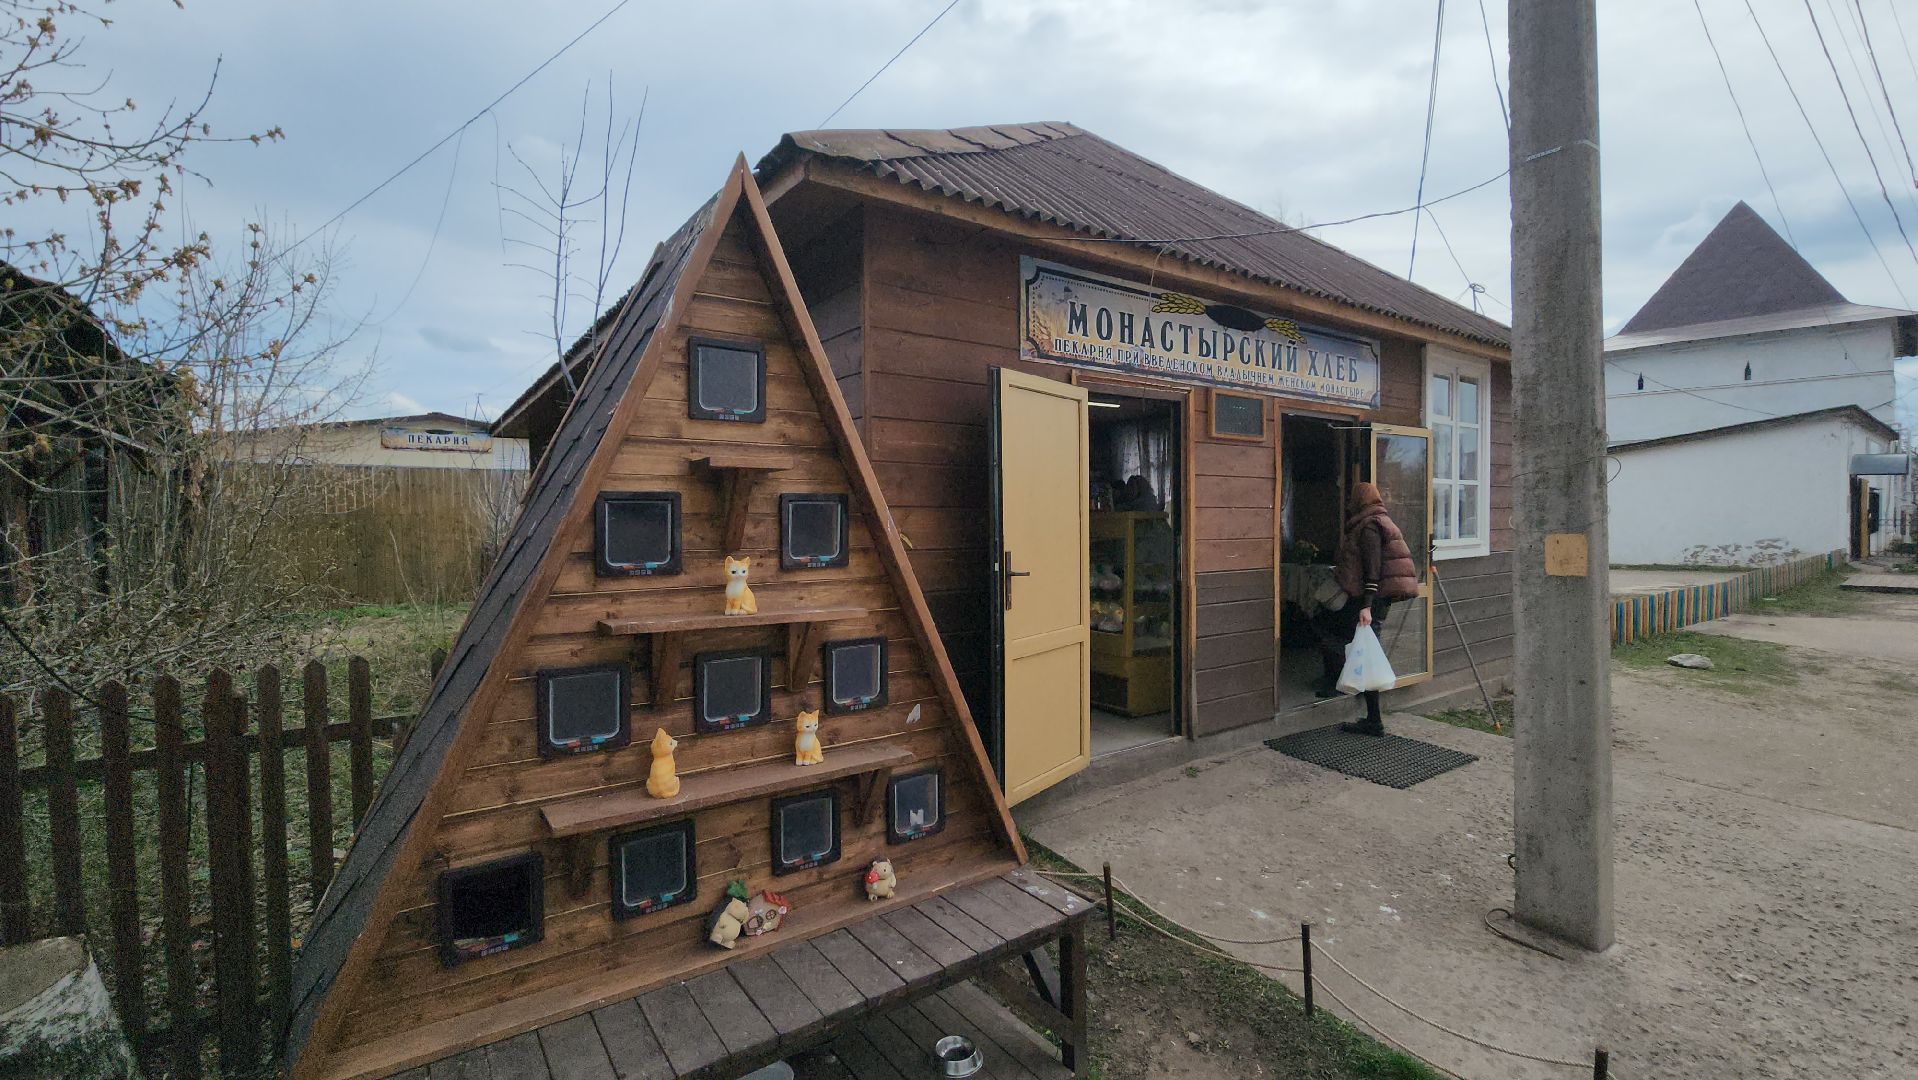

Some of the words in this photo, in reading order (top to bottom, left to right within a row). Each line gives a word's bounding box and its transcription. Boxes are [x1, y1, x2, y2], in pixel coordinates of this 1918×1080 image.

[1054, 338, 1112, 360] ПЕКАРНЯ
[1117, 349, 1139, 364] ПРИ
[1144, 353, 1213, 376] ВВЕДЕНСКОМ
[1217, 365, 1274, 385] ВЛАДЫЧНЕМ
[1278, 375, 1316, 391] ЖЕНСКОМ
[1067, 300, 1298, 374] МОНАСТЫРСКИЙ
[1307, 349, 1358, 383] ХЛЕБ
[408, 434, 469, 446] ПЕКАРНЯ
